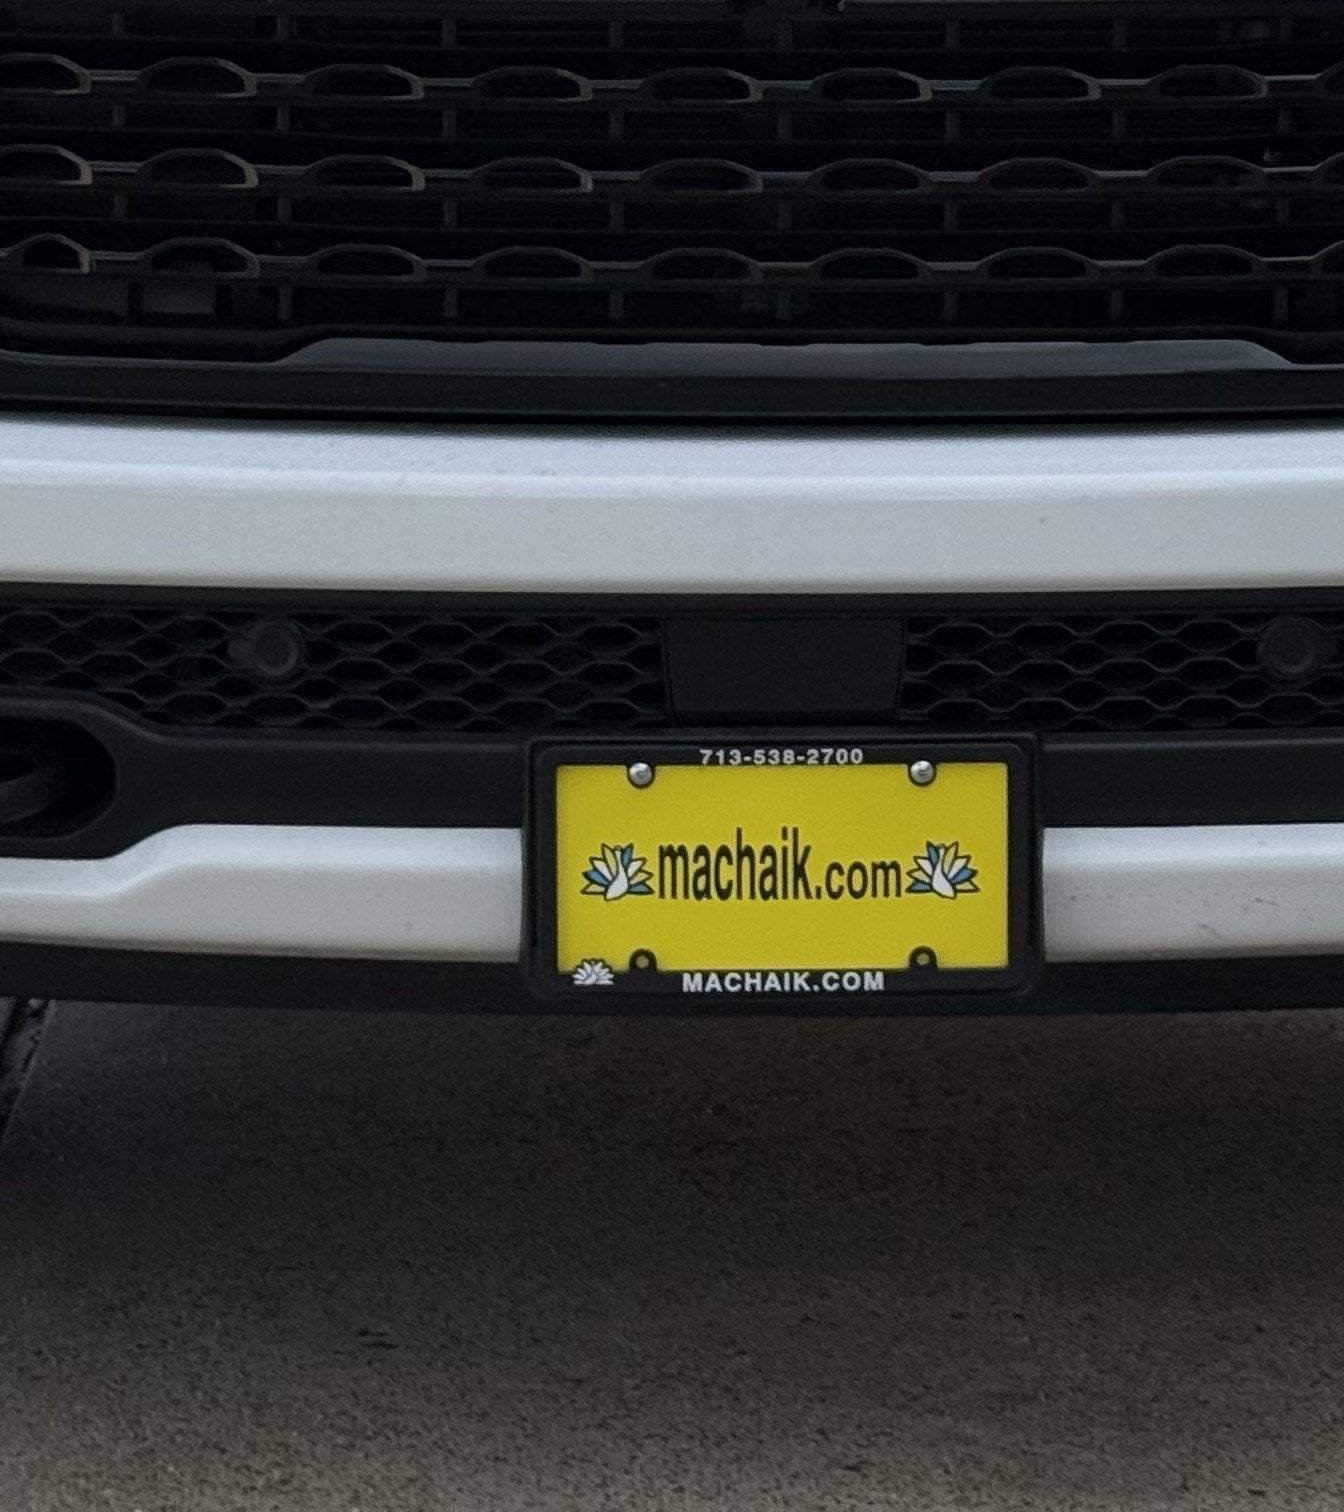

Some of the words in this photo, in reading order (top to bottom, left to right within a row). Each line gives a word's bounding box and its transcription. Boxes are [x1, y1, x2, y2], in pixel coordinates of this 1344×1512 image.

[699, 748, 864, 765] 713-538-2700
[657, 826, 903, 900] machaik.com
[682, 972, 886, 994] MACHAIK.COM
